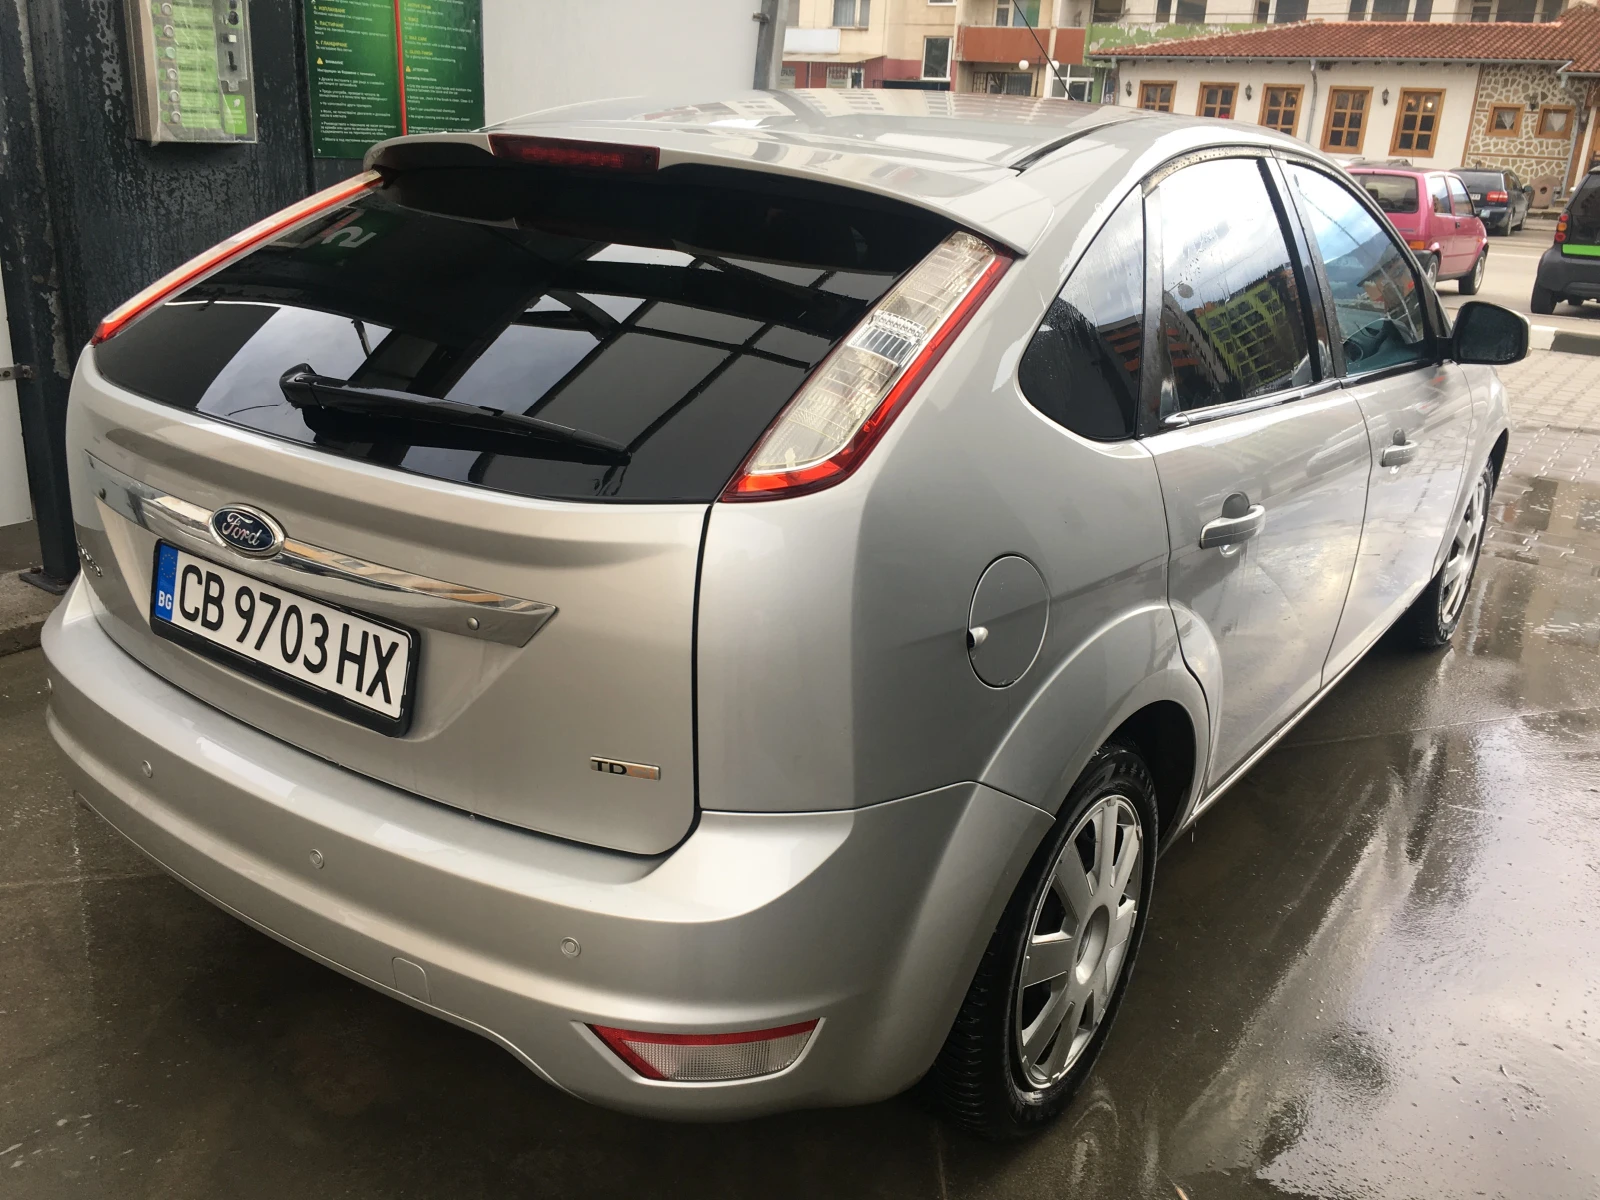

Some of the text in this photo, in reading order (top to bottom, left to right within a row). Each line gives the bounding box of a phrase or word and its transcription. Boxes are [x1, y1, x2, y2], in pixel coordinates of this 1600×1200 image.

[222, 511, 263, 547] Ford
[158, 590, 172, 610] BG
[179, 563, 400, 705] CB 9703 HX
